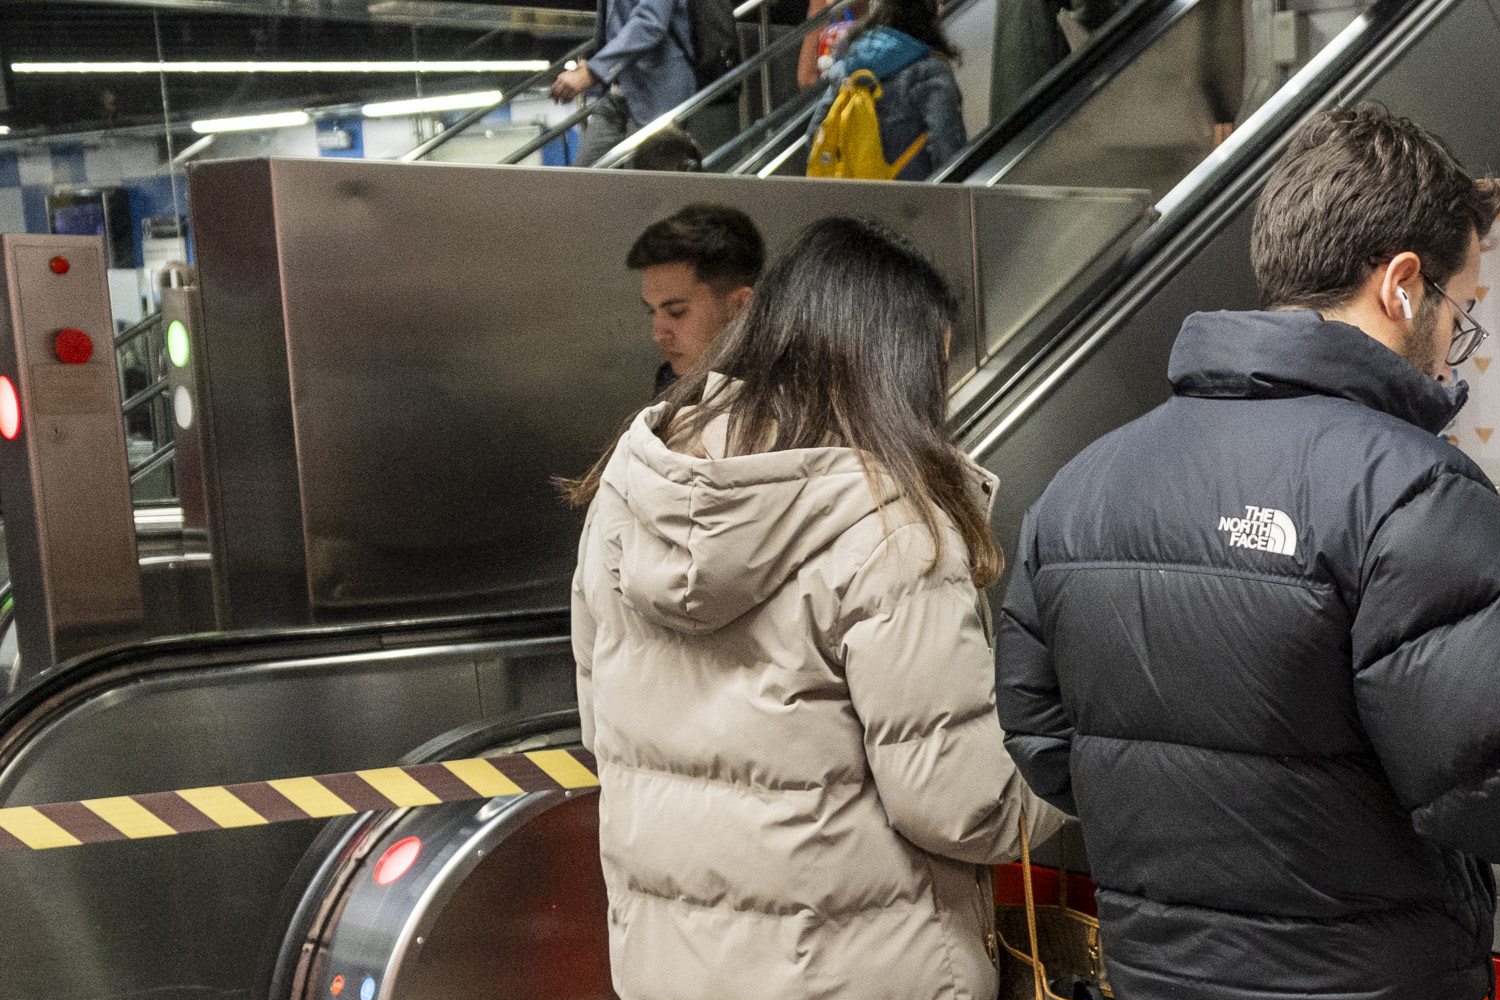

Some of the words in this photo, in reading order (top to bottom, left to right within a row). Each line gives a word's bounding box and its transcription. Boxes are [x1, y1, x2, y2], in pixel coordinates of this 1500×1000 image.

[1245, 505, 1275, 523] THE
[1217, 516, 1272, 537] NORTH
[1229, 531, 1270, 551] FACE
